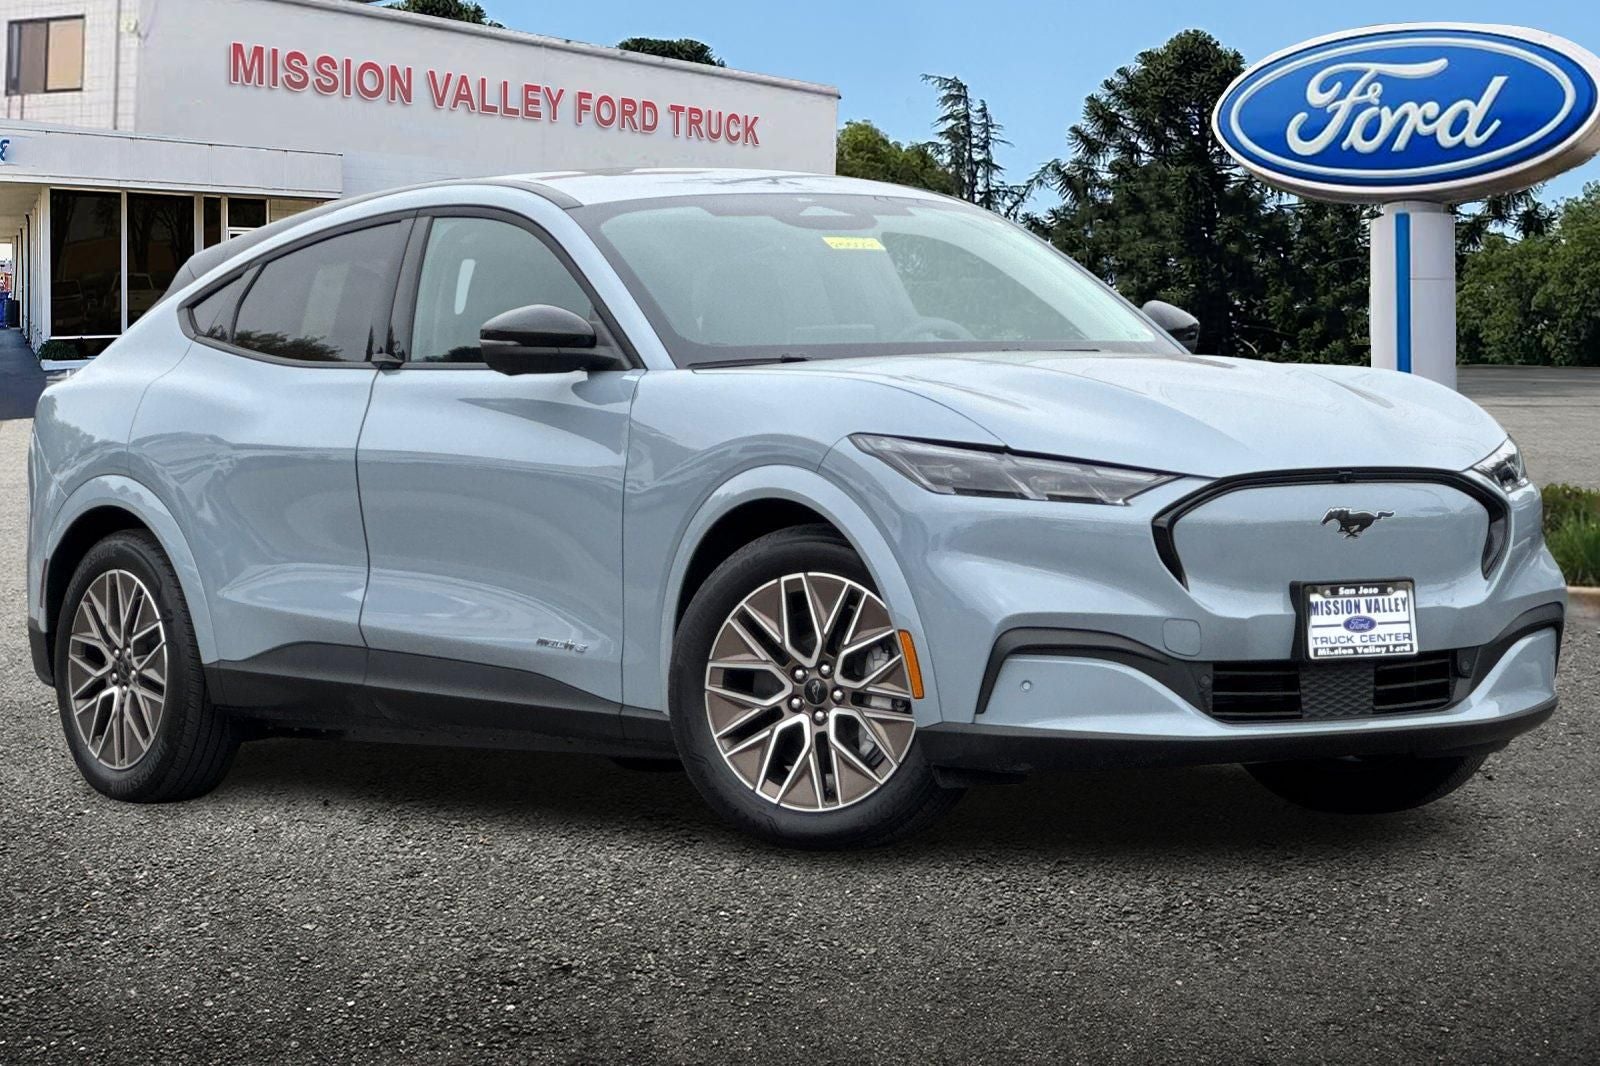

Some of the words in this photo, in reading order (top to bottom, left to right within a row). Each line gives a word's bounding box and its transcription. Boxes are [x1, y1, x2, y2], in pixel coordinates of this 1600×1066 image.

[230, 41, 413, 104] MISSION
[427, 69, 565, 122] VALLEY
[575, 90, 659, 133] FORD
[668, 103, 760, 146] TRUCK
[1286, 58, 1509, 156] Ford
[1338, 586, 1356, 595] San
[1359, 586, 1379, 595] Jose
[1310, 599, 1361, 616] MISSION
[1365, 597, 1407, 614] VALLEY
[1349, 618, 1370, 631] Ford
[1312, 635, 1355, 646] TRUCK
[1360, 632, 1412, 645] CENTER
[1356, 645, 1387, 655] Valley
